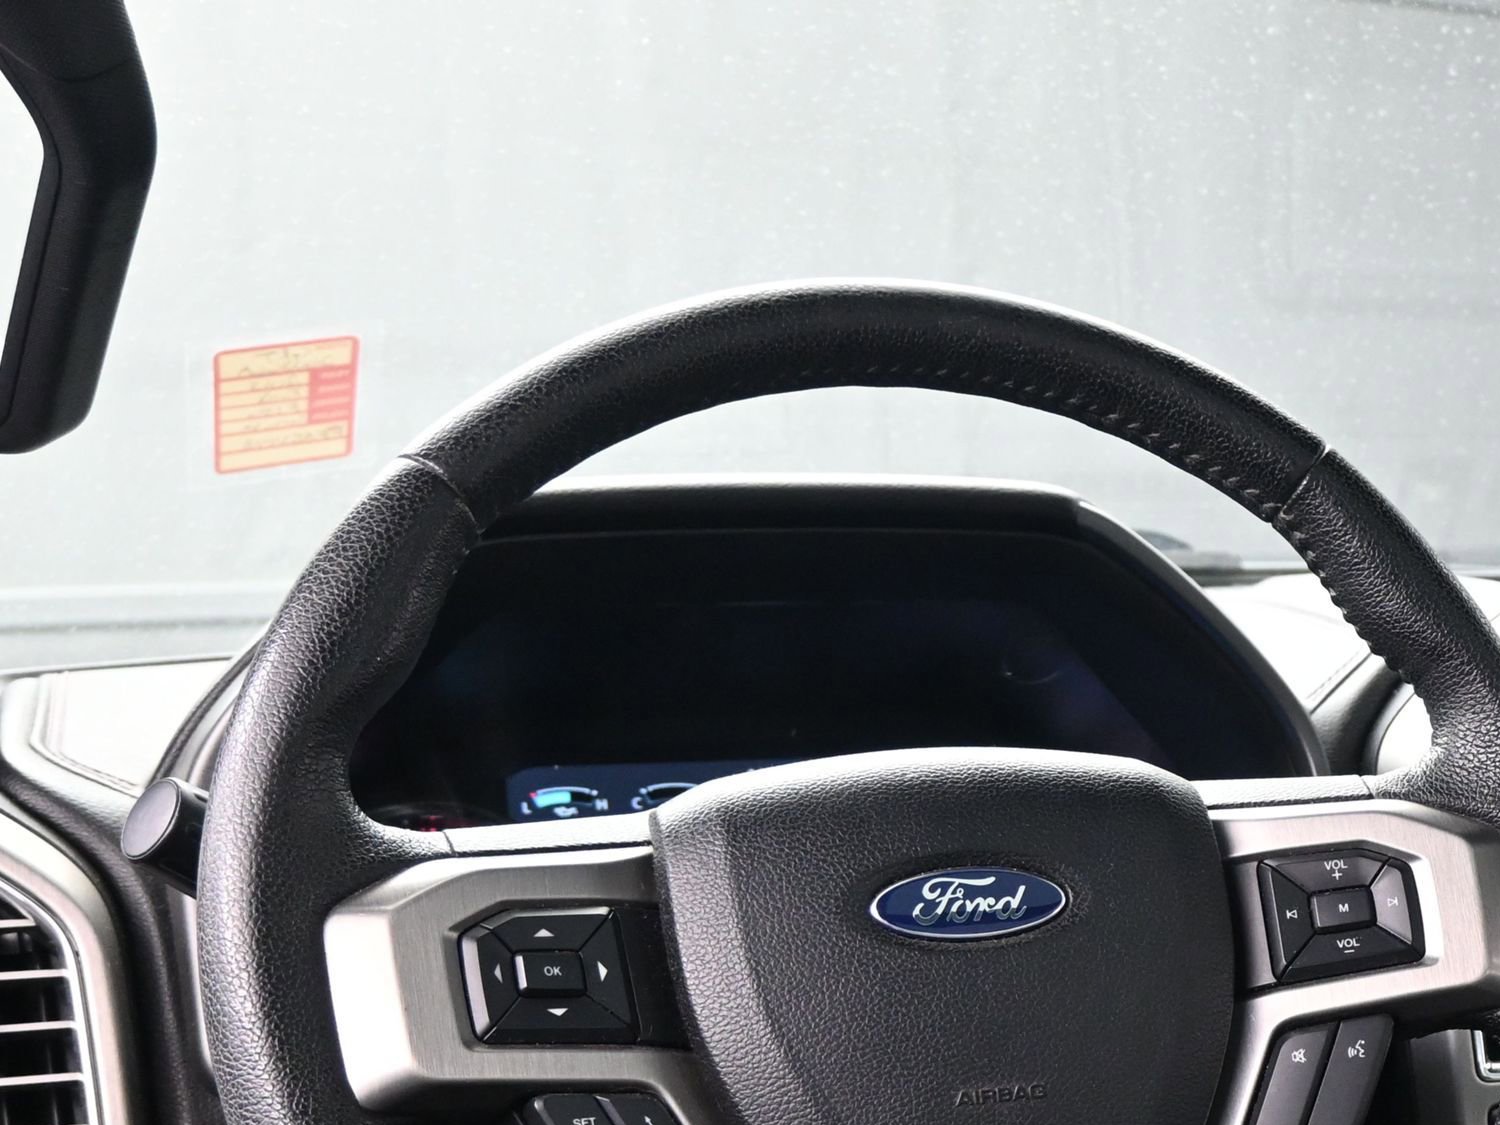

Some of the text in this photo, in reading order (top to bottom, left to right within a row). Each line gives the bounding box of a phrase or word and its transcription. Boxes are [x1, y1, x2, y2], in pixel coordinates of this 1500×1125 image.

[1324, 859, 1348, 870] VOL
[912, 876, 1027, 926] Ford
[1338, 903, 1349, 913] M
[1336, 938, 1360, 949] VOL
[543, 966, 562, 977] OK
[955, 1083, 1047, 1107] AIRBAG
